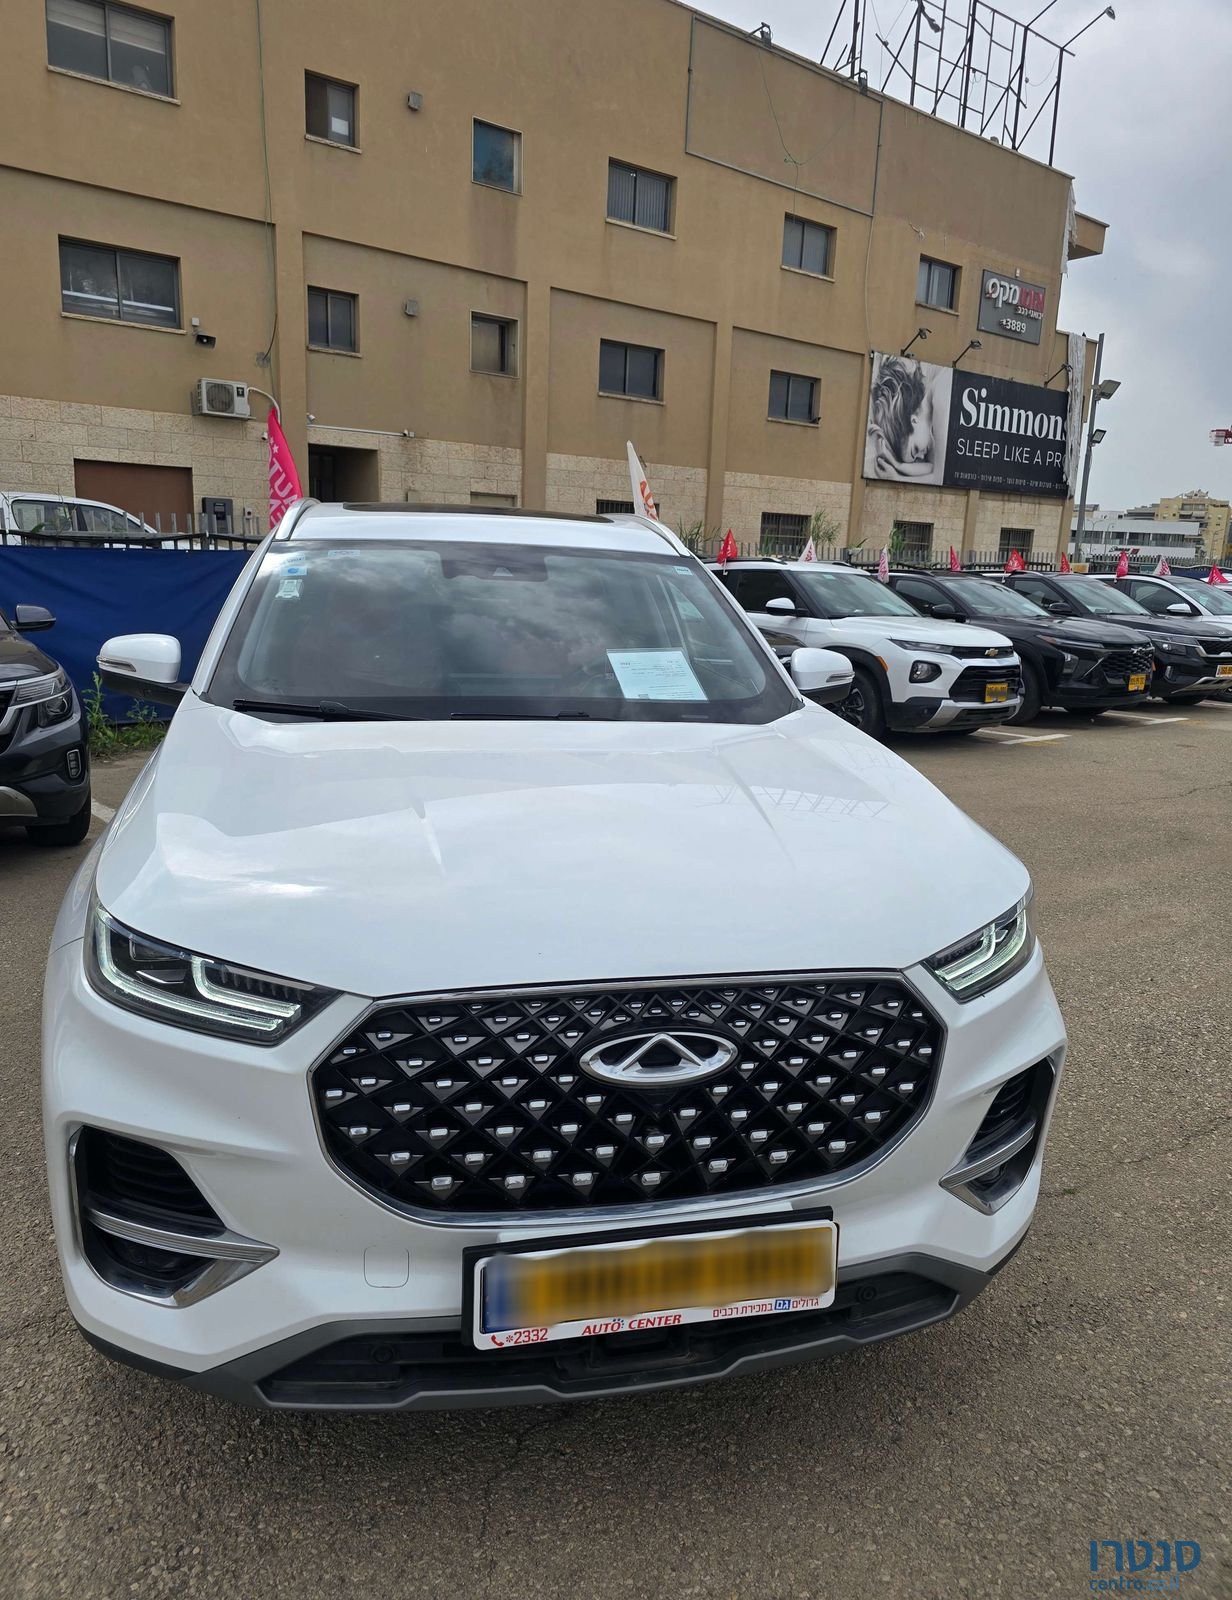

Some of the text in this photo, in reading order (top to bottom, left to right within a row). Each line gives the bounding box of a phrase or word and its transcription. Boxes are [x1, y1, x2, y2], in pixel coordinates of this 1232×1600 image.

[956, 438, 1000, 459] SLEEP
[1003, 445, 1031, 464] LIKE
[1033, 449, 1042, 465] A
[713, 1298, 819, 1318] גדולים גם במכירת רכבים
[582, 1314, 682, 1336] AUTO CENTER
